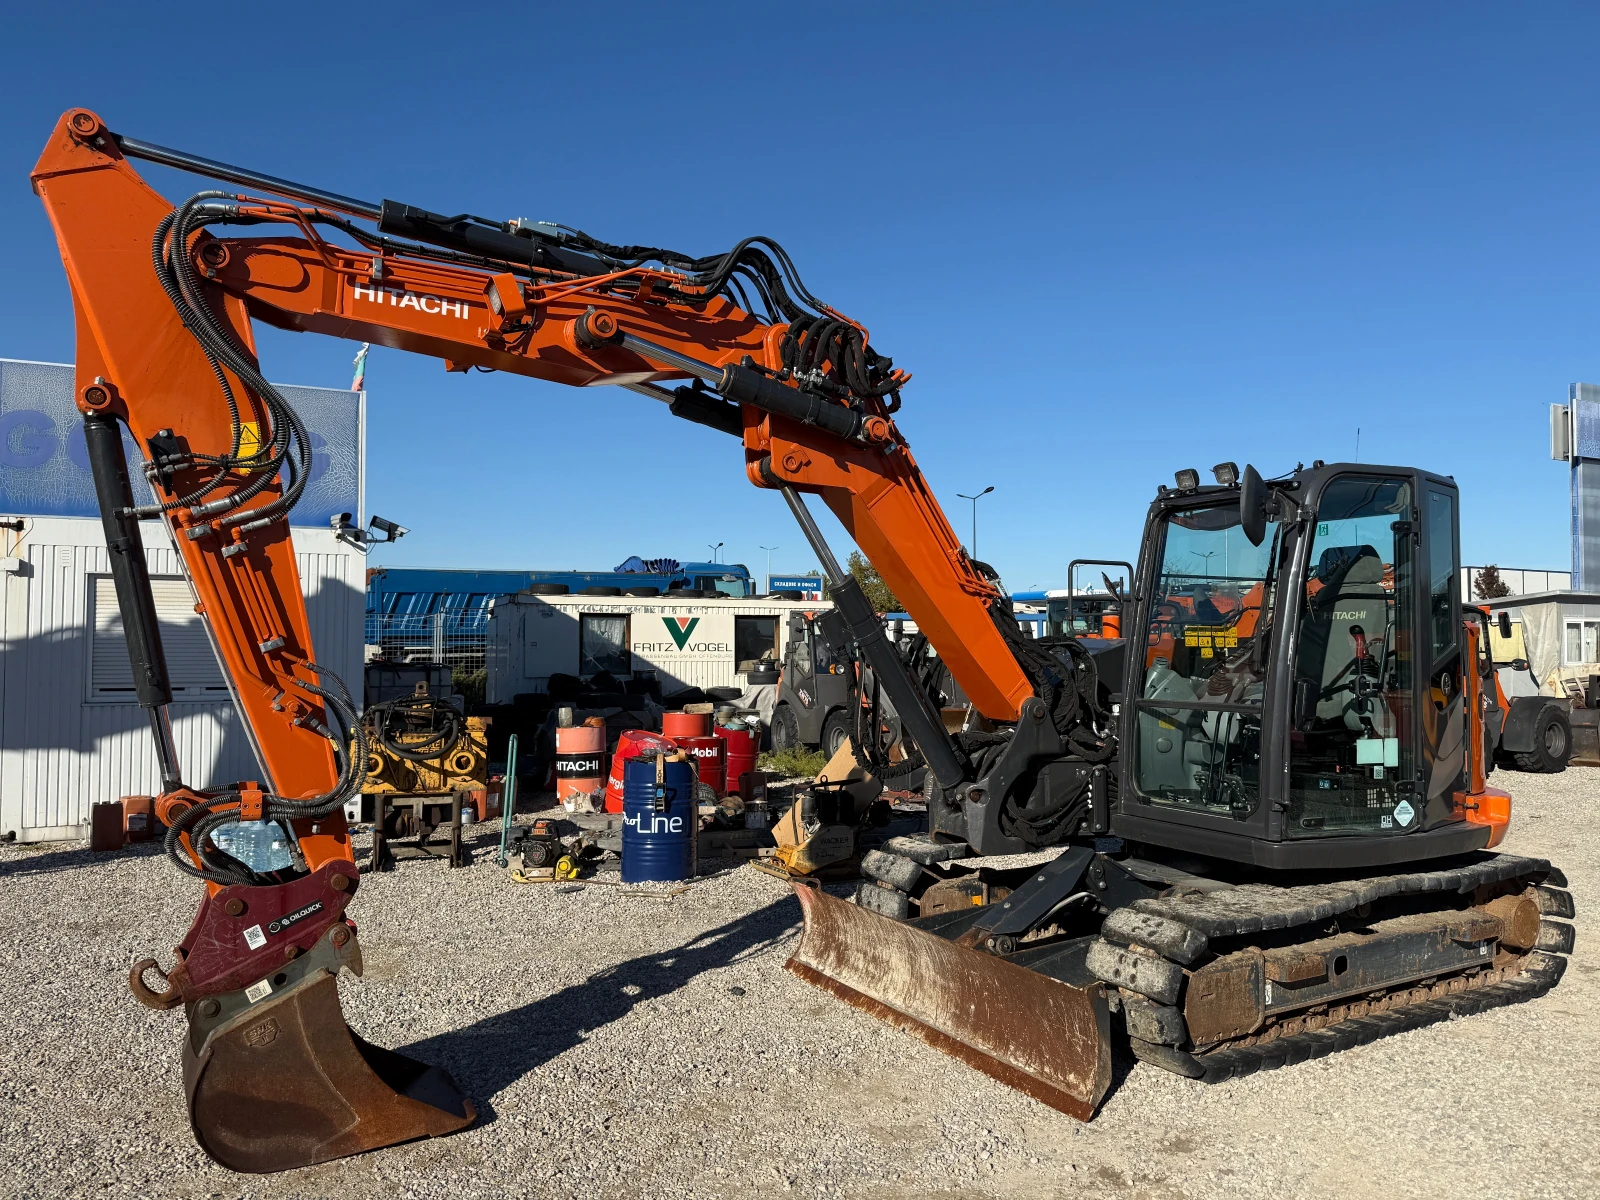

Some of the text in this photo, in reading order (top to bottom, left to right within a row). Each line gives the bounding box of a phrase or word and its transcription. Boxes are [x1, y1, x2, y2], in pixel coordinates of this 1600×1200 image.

[353, 282, 469, 320] HITACHI
[1323, 610, 1367, 620] HITACHI
[633, 642, 733, 652] FRITZ VOGEL
[691, 746, 718, 758] Mobil
[556, 760, 599, 772] HITACHI
[609, 775, 625, 790] ergi
[820, 836, 849, 845] WACKER
[289, 902, 322, 922] OILQUICK
